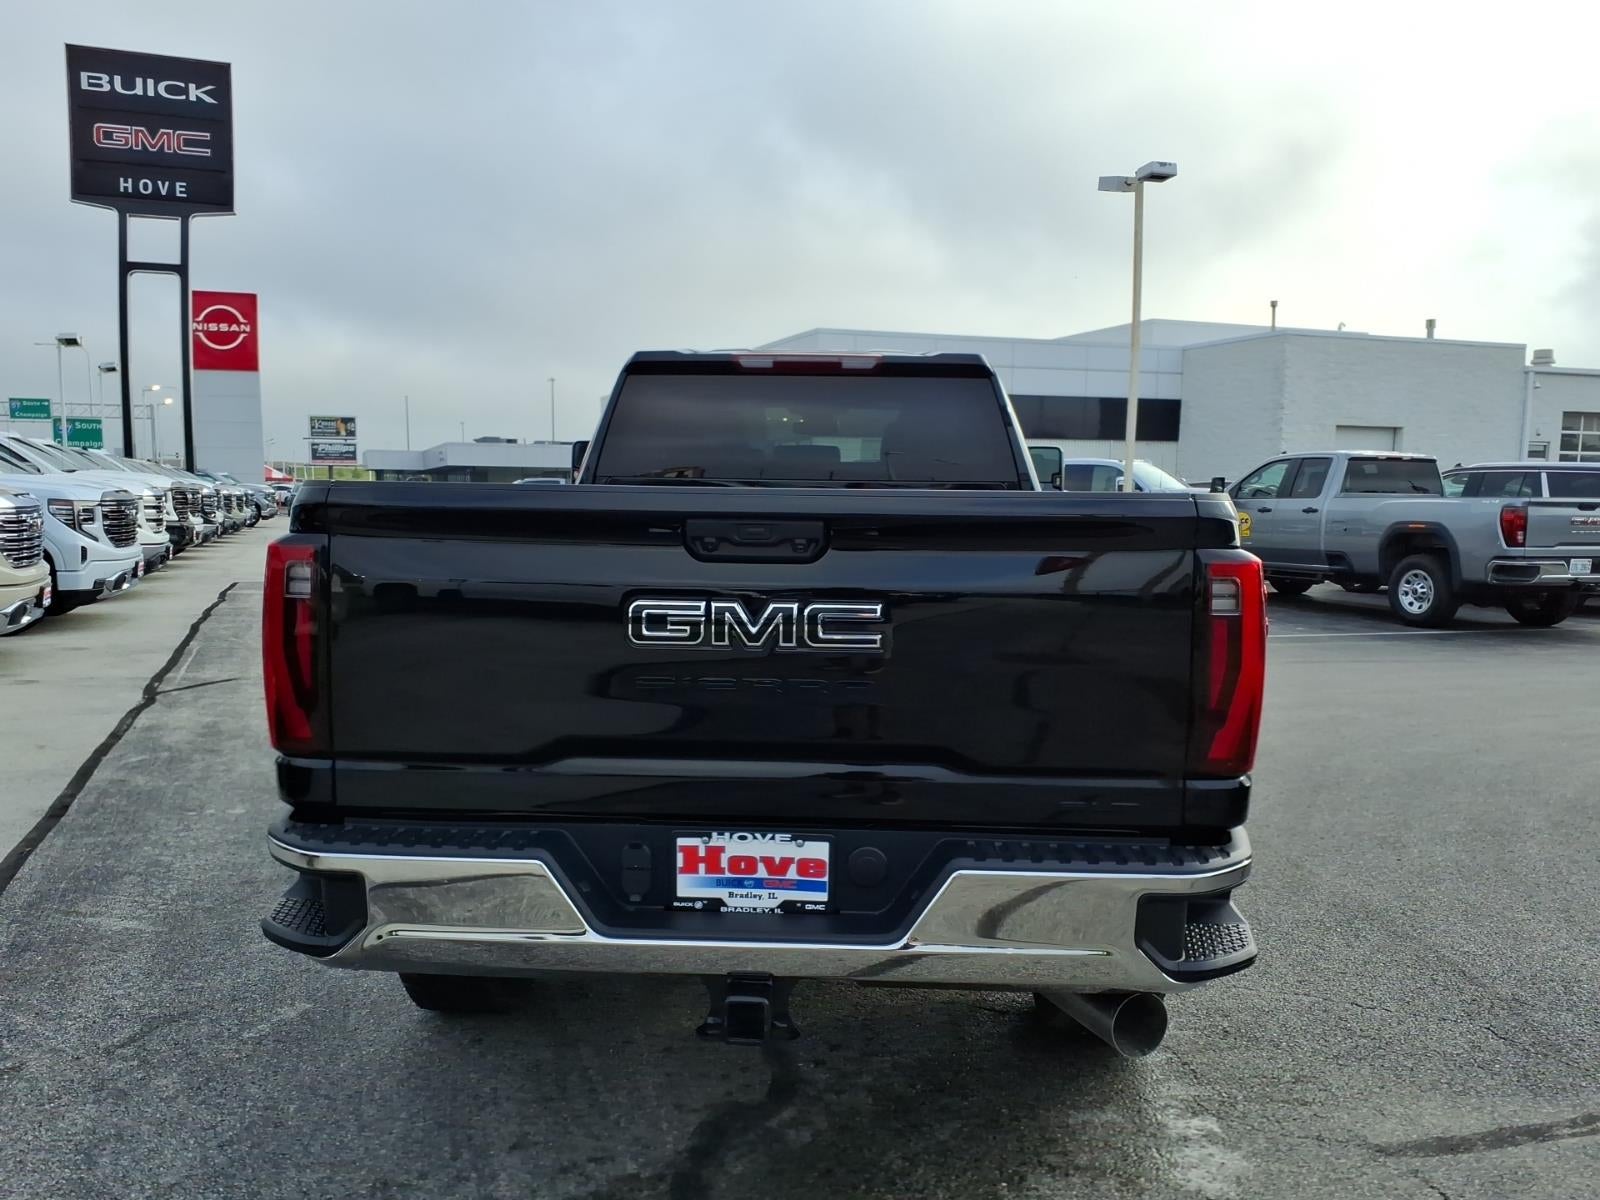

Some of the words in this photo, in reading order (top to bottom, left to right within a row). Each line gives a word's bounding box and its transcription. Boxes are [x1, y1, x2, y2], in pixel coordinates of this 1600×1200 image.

[80, 71, 218, 104] BUICK
[93, 122, 211, 157] GMC
[119, 177, 187, 197] HOVE
[192, 322, 251, 332] NISSAN
[55, 438, 103, 448] Campaign
[628, 599, 882, 647] GMC
[711, 831, 792, 844] HOVE
[678, 845, 827, 879] Hove
[728, 891, 764, 900] Bradley,
[720, 906, 771, 914] BRADLEY,
